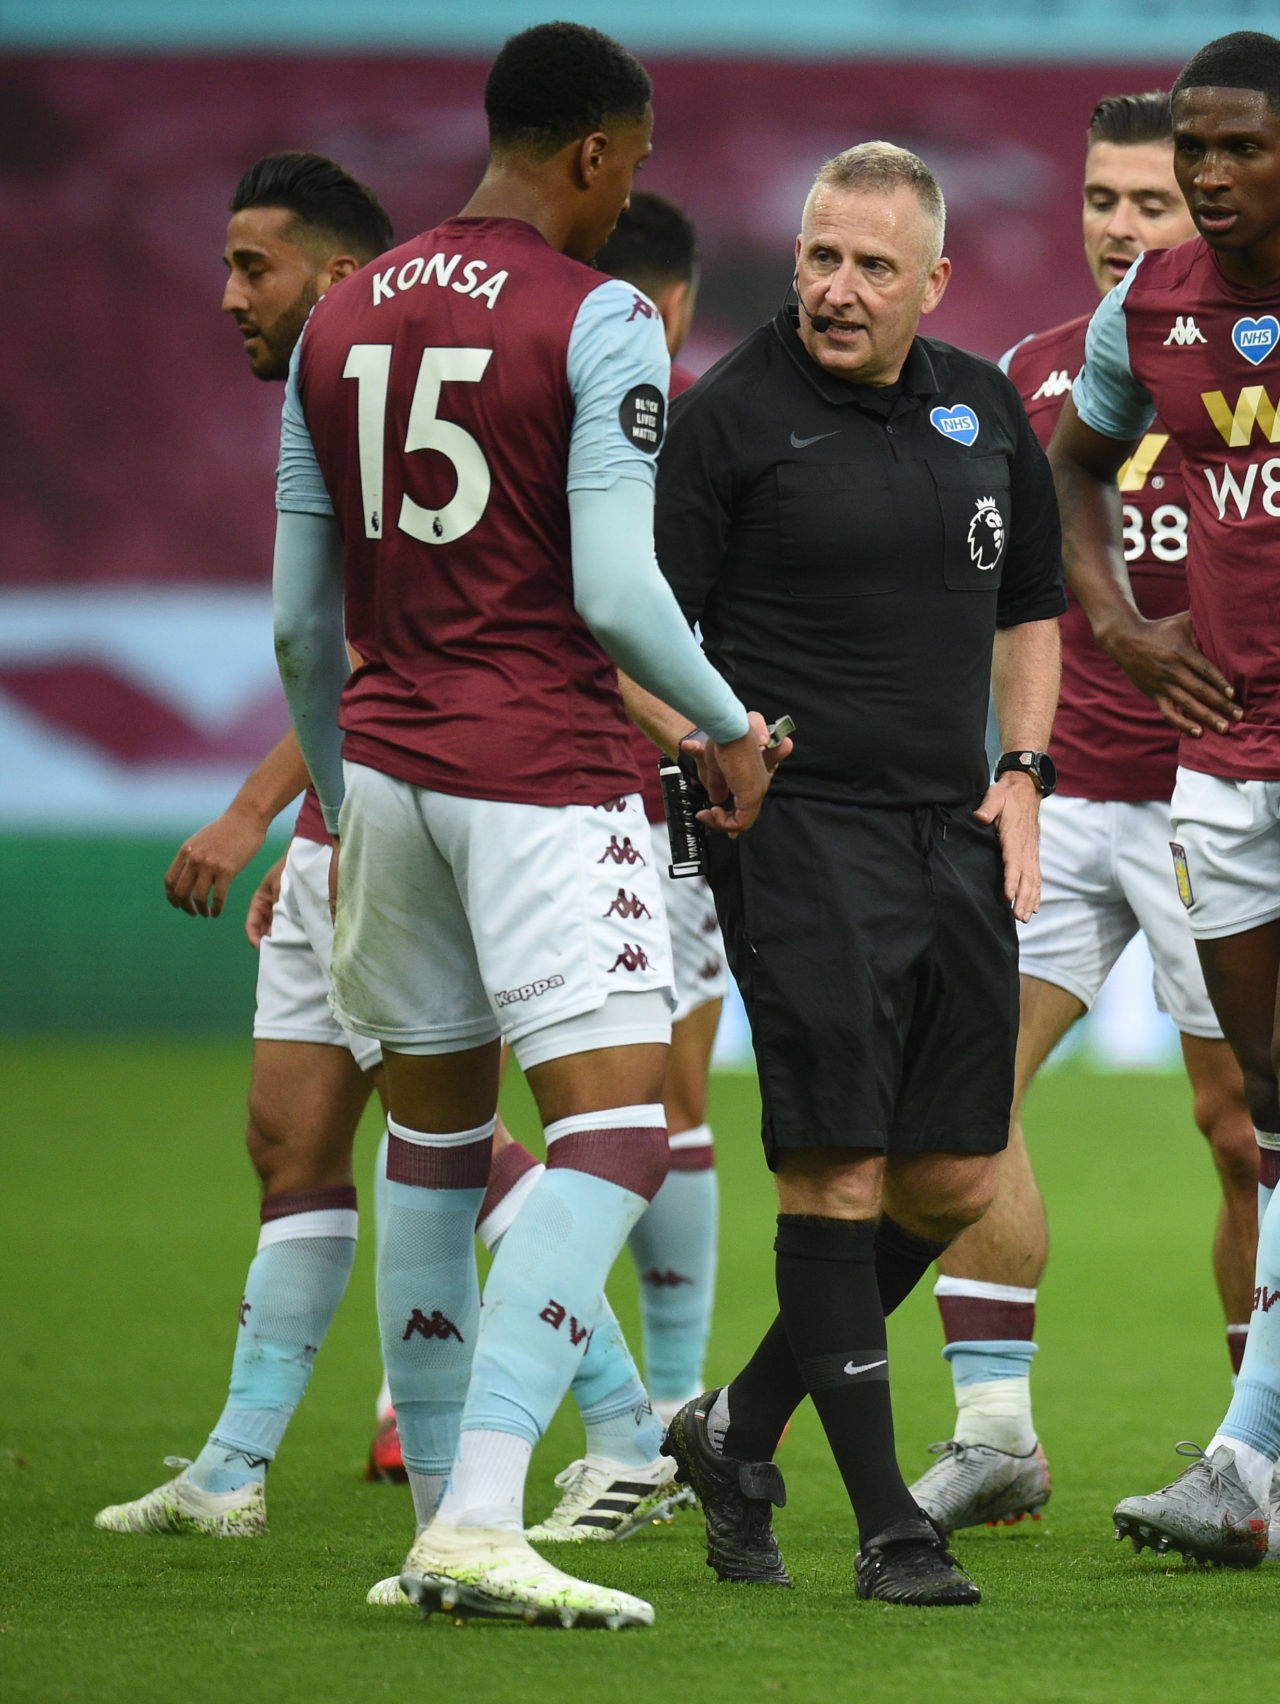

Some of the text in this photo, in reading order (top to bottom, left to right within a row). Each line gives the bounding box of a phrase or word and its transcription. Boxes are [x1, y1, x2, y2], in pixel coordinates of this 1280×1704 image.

[372, 252, 509, 310] KONSA
[1241, 330, 1270, 346] NHS
[342, 343, 494, 545] 15
[942, 417, 972, 431] NHS
[1122, 504, 1189, 562] 88
[494, 974, 565, 1008] Kappa
[539, 1298, 594, 1357] av
